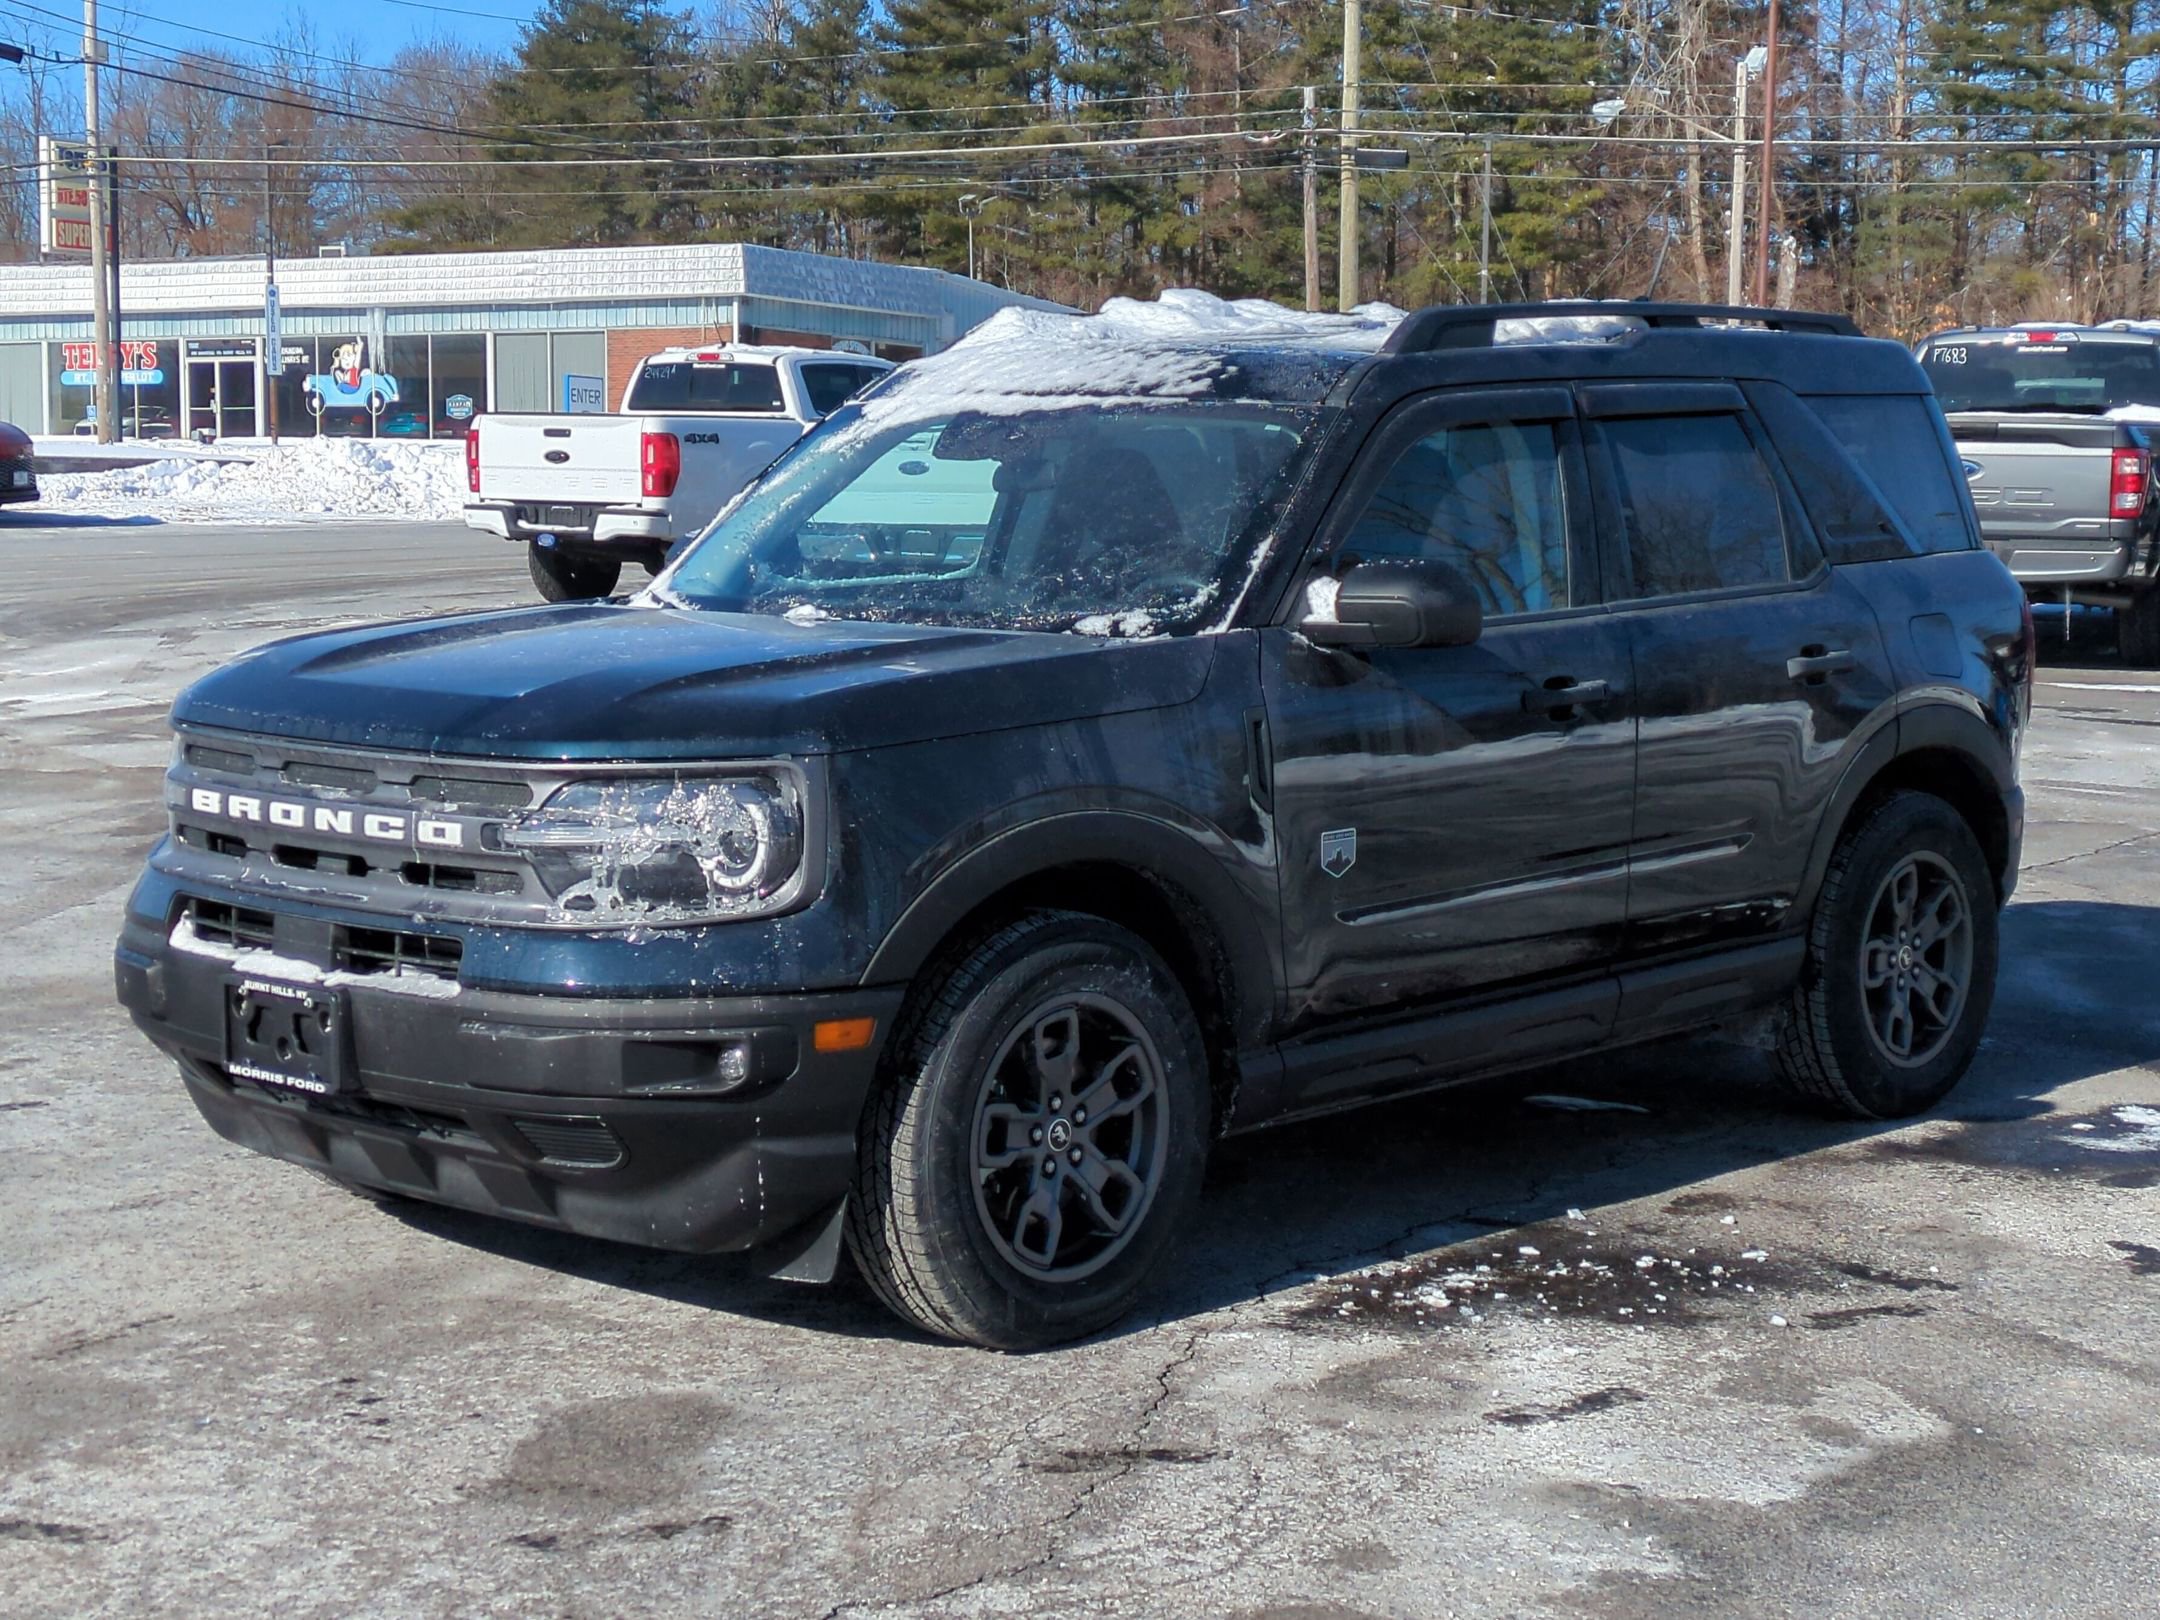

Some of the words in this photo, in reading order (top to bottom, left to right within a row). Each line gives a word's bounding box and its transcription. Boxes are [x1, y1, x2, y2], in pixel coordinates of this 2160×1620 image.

[1932, 347, 1967, 364] P7683
[571, 388, 601, 404] ENTER
[191, 788, 463, 846] BRONCO
[244, 979, 271, 993] BURNT
[296, 990, 309, 1000] NY
[229, 1064, 285, 1084] MORRIS
[286, 1076, 326, 1093] FORD
